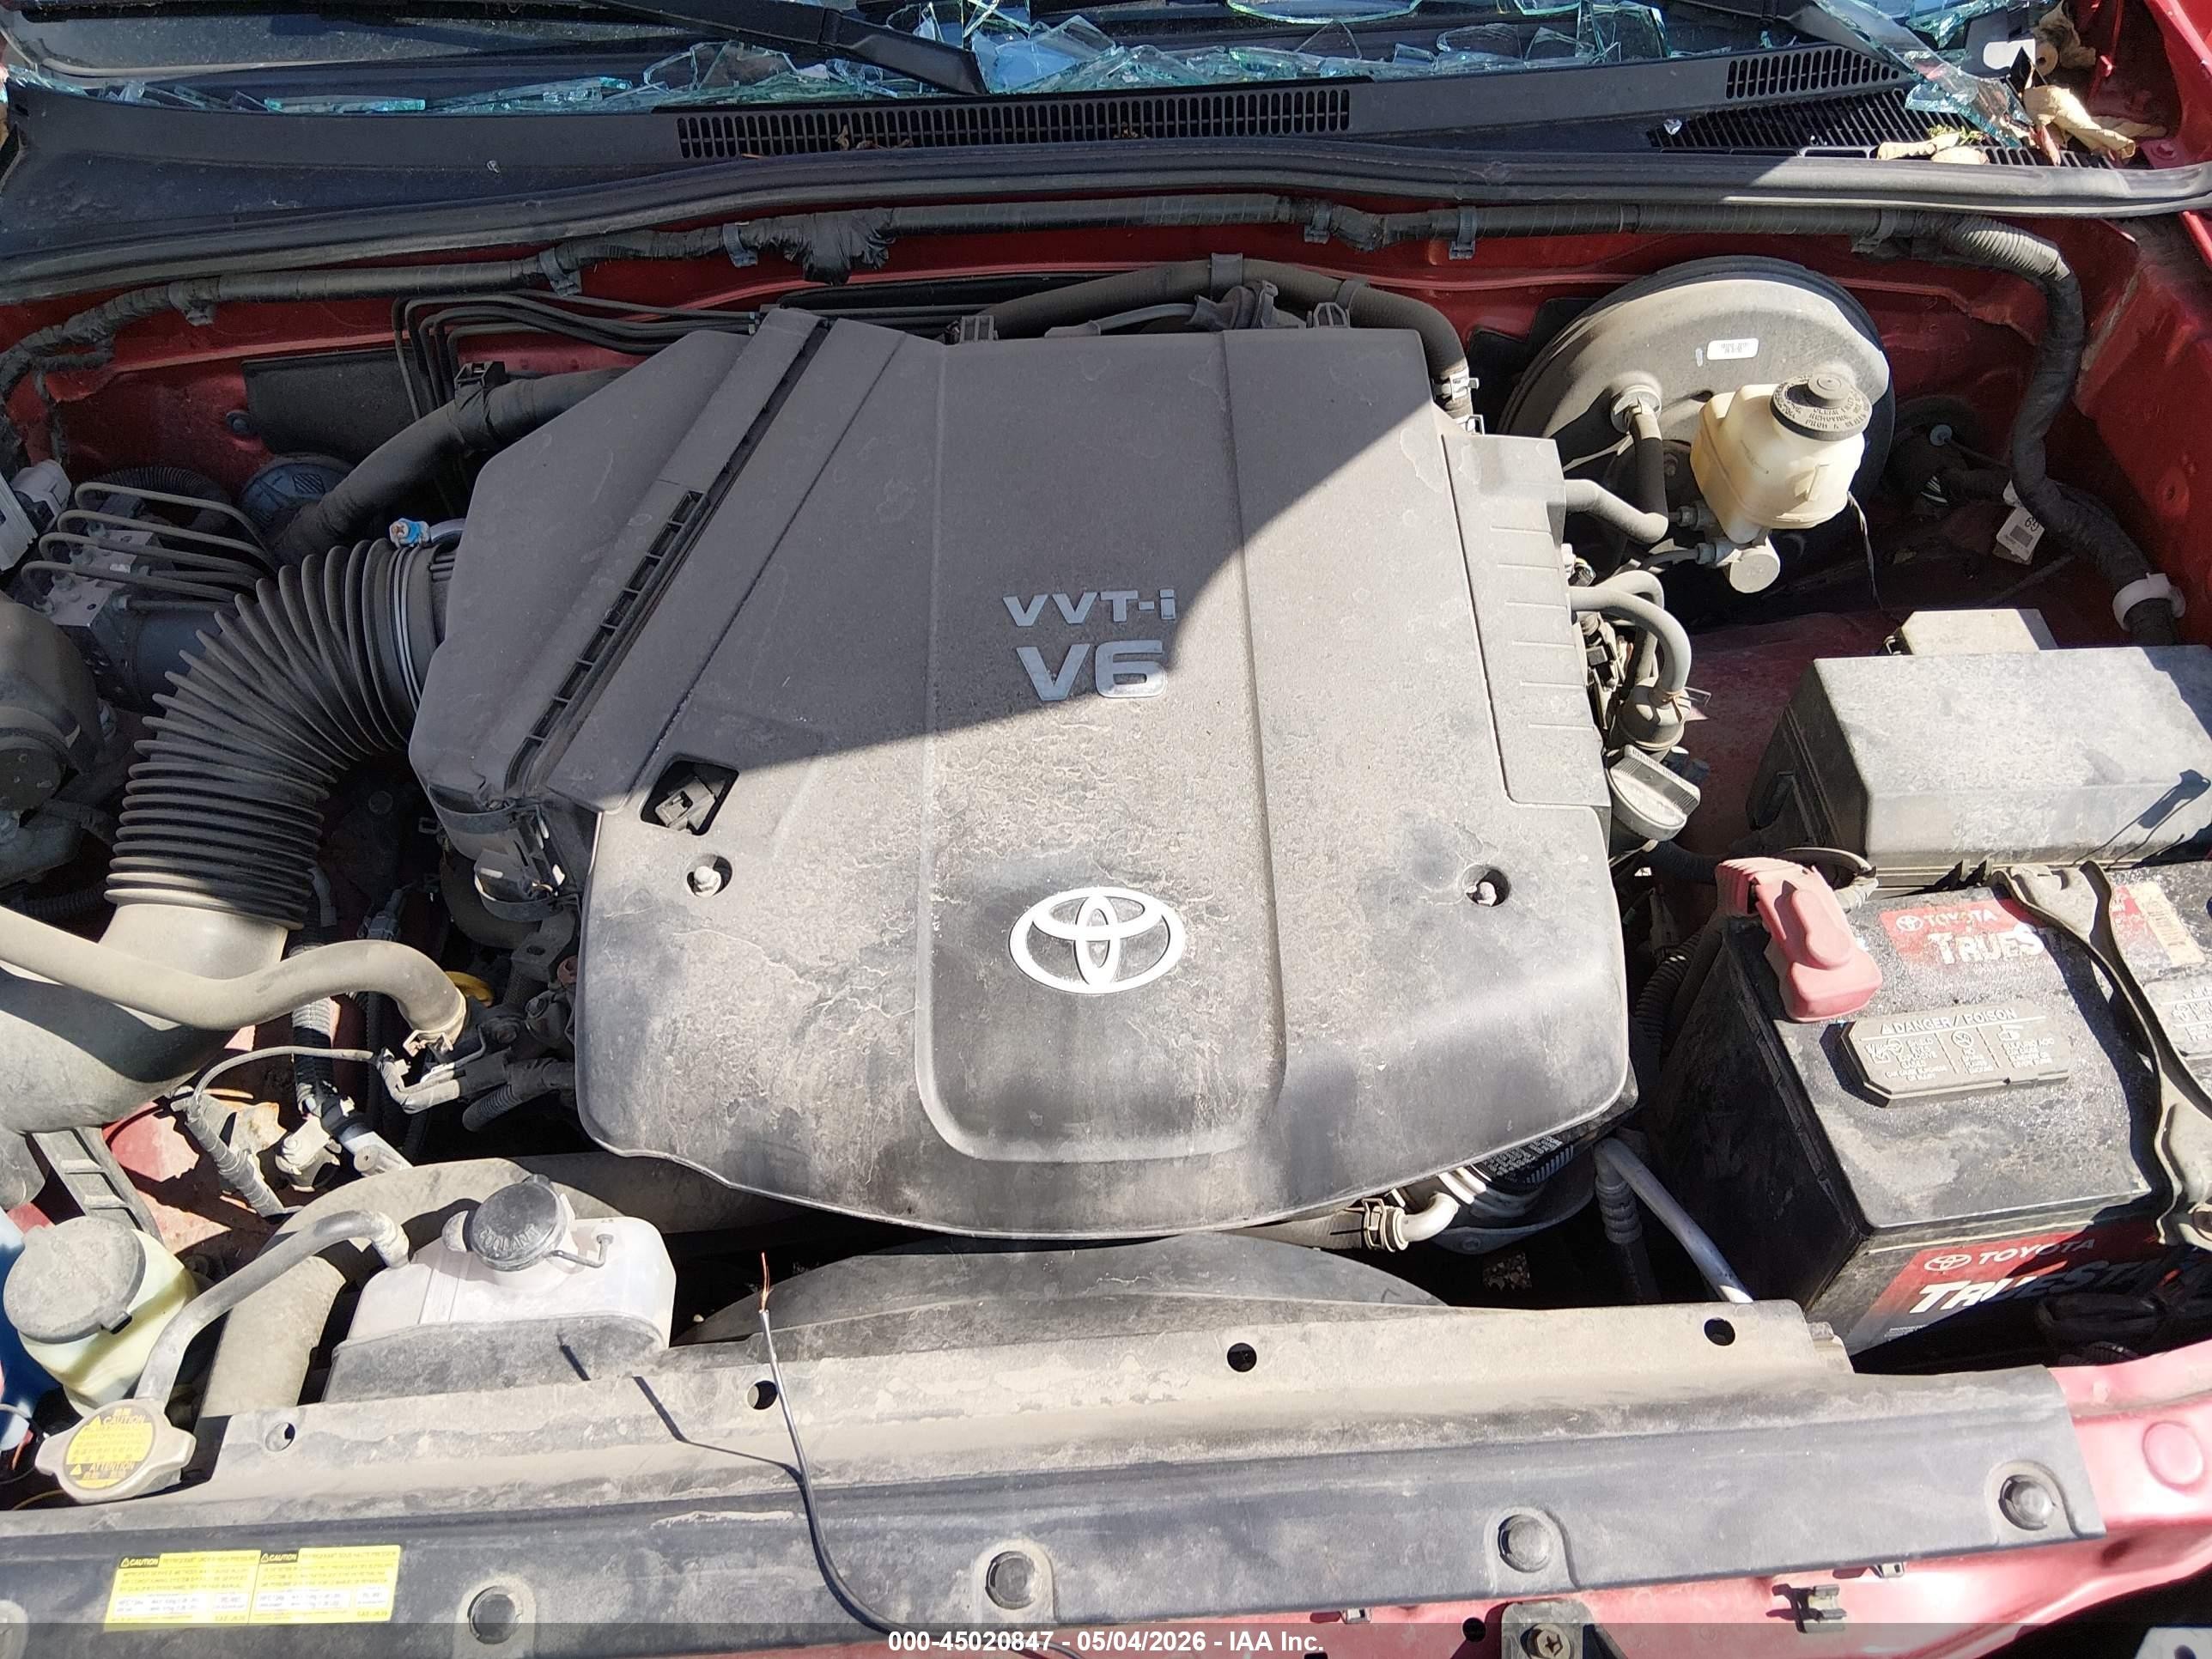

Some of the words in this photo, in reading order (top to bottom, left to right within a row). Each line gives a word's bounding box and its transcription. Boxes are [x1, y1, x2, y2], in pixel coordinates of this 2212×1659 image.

[1002, 588, 1176, 627] VVT-i
[1016, 640, 1167, 701] V6
[1923, 909, 1997, 927] TOYOTA
[1892, 1017, 1951, 1034] DANGER
[1962, 1008, 2017, 1024] POISON
[480, 1223, 540, 1251] COOLANT
[1978, 1238, 2095, 1265] TOYOTA
[104, 1414, 146, 1425] CAUTION
[130, 1558, 159, 1567] CAUTION
